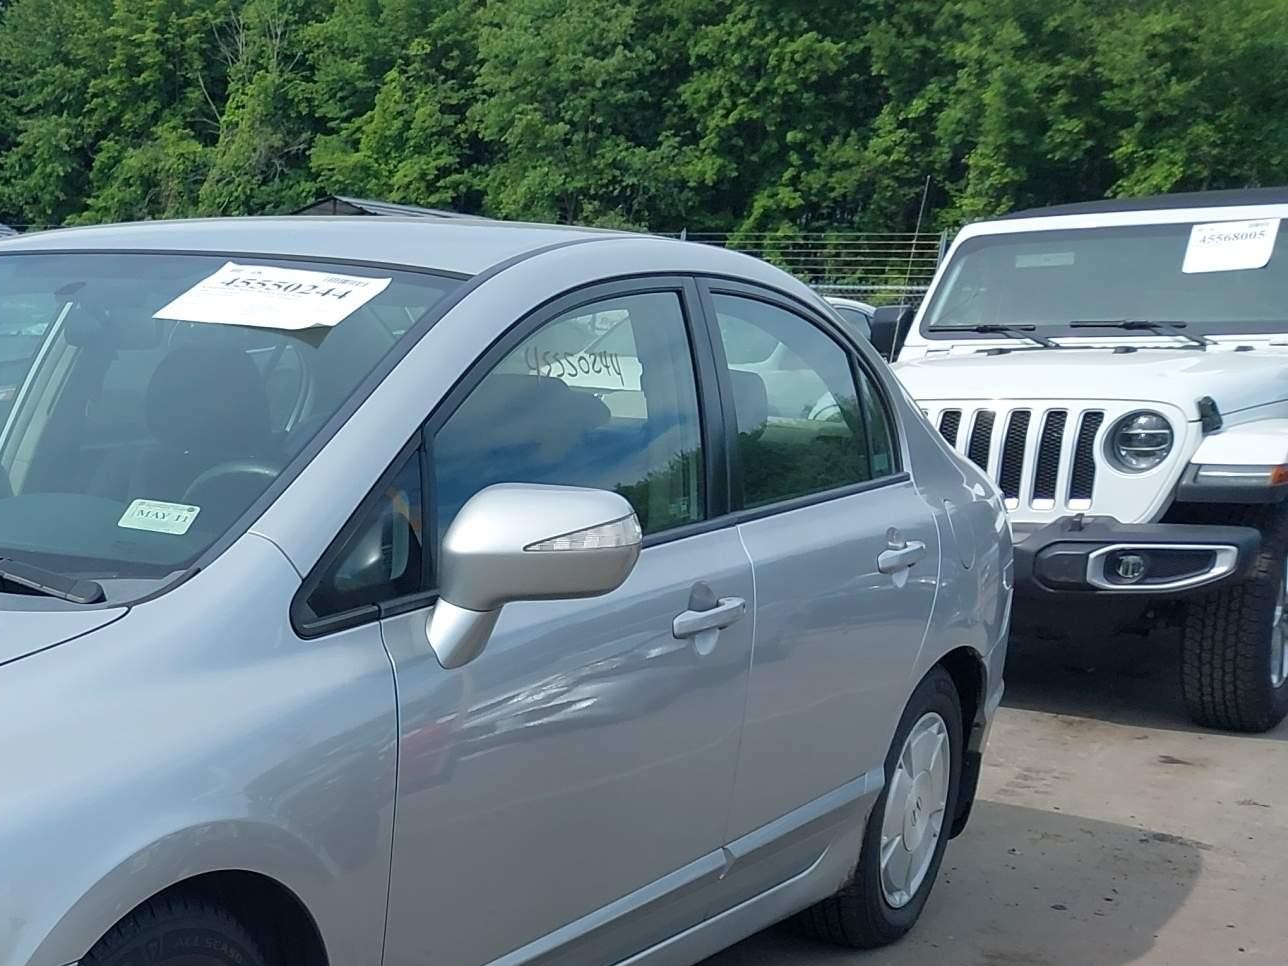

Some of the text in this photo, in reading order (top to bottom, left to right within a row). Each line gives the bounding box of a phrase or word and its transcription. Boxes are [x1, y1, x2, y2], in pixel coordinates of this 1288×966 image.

[1199, 229, 1266, 244] 45568005
[220, 277, 352, 300] 45550244
[136, 509, 171, 520] MAY
